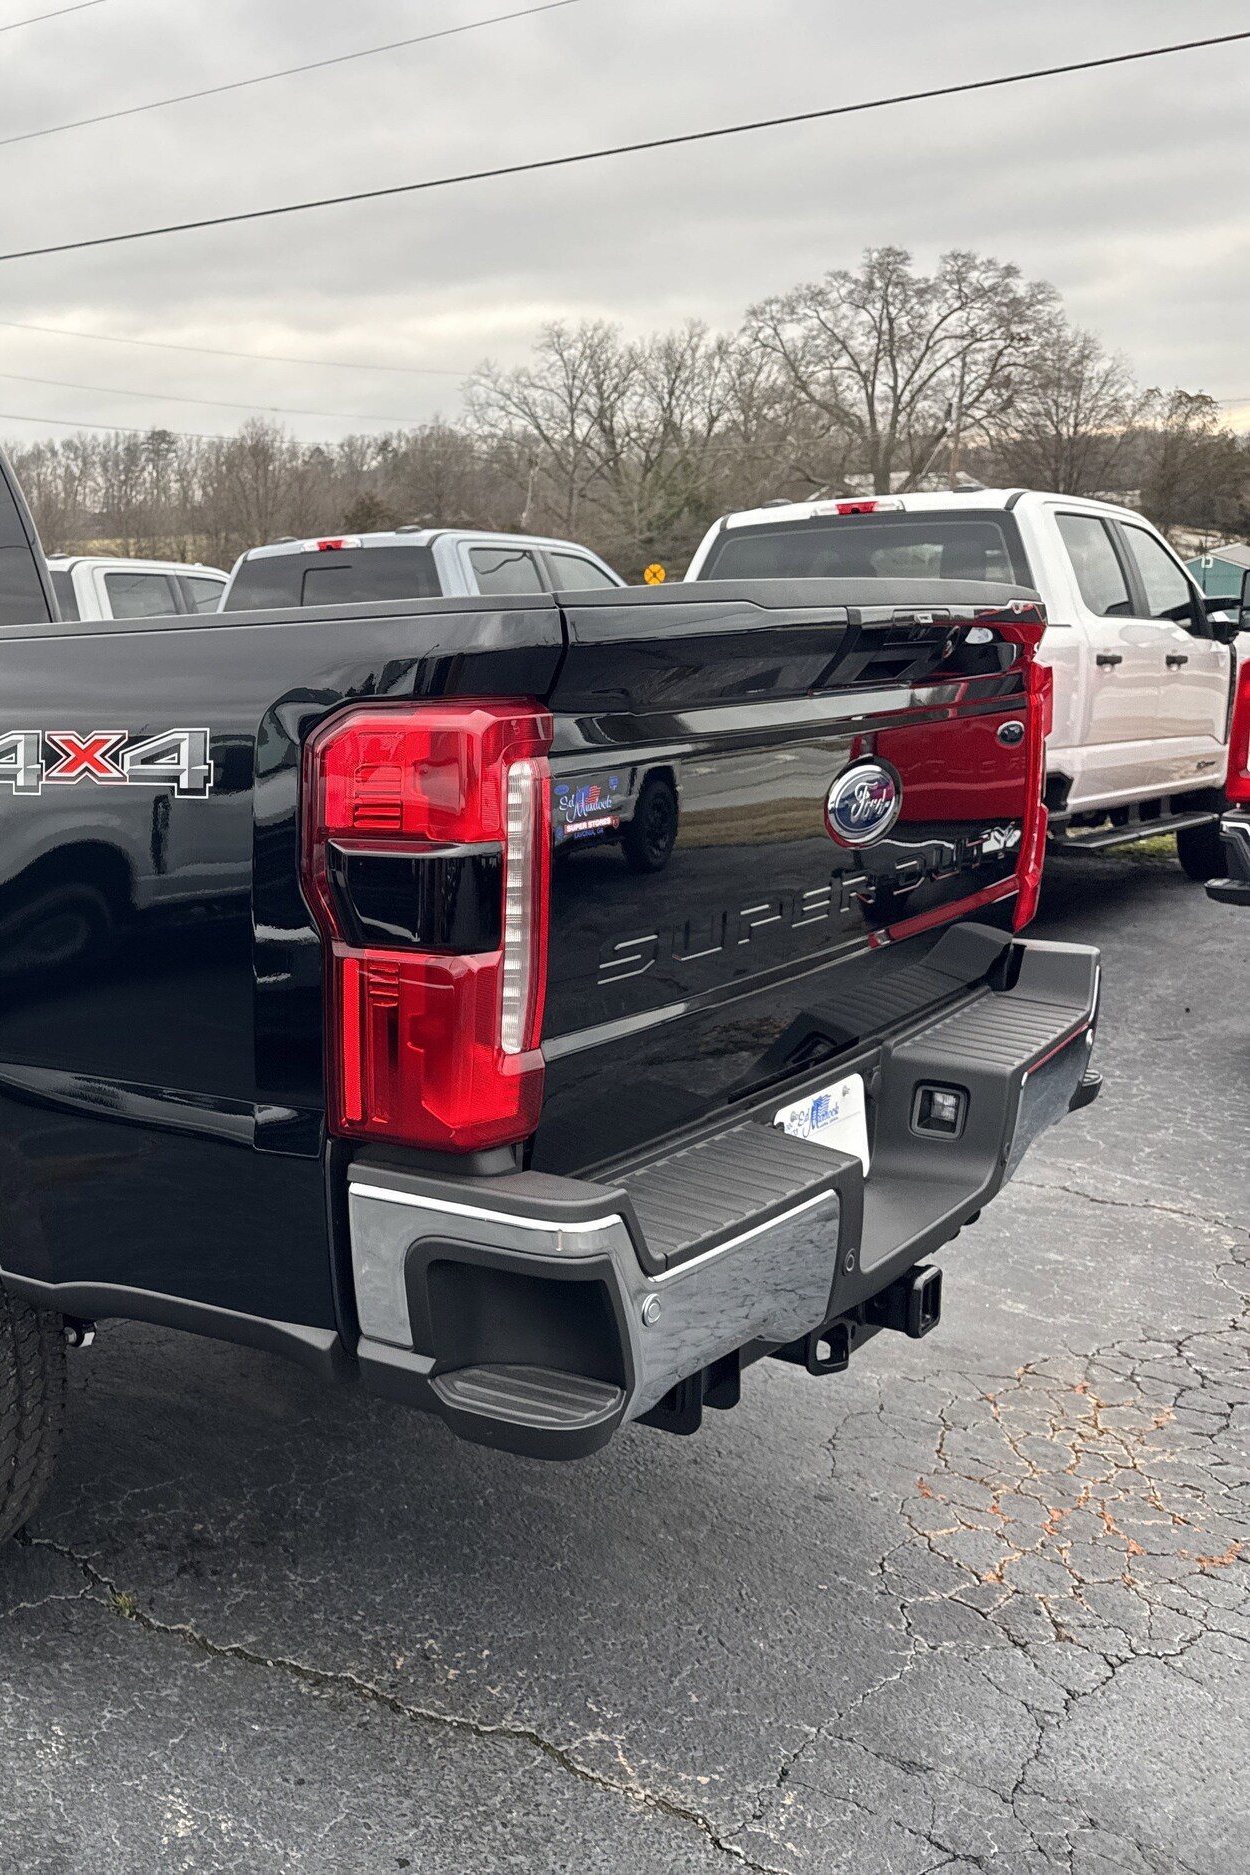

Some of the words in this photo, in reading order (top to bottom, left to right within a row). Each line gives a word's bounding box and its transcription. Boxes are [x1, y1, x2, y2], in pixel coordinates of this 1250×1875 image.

[559, 794, 575, 811] Ed
[851, 781, 890, 822] Ford
[566, 821, 587, 833] SUPER
[588, 816, 611, 829] STORES
[597, 868, 876, 985] SUPER
[893, 821, 1021, 895] DUTY
